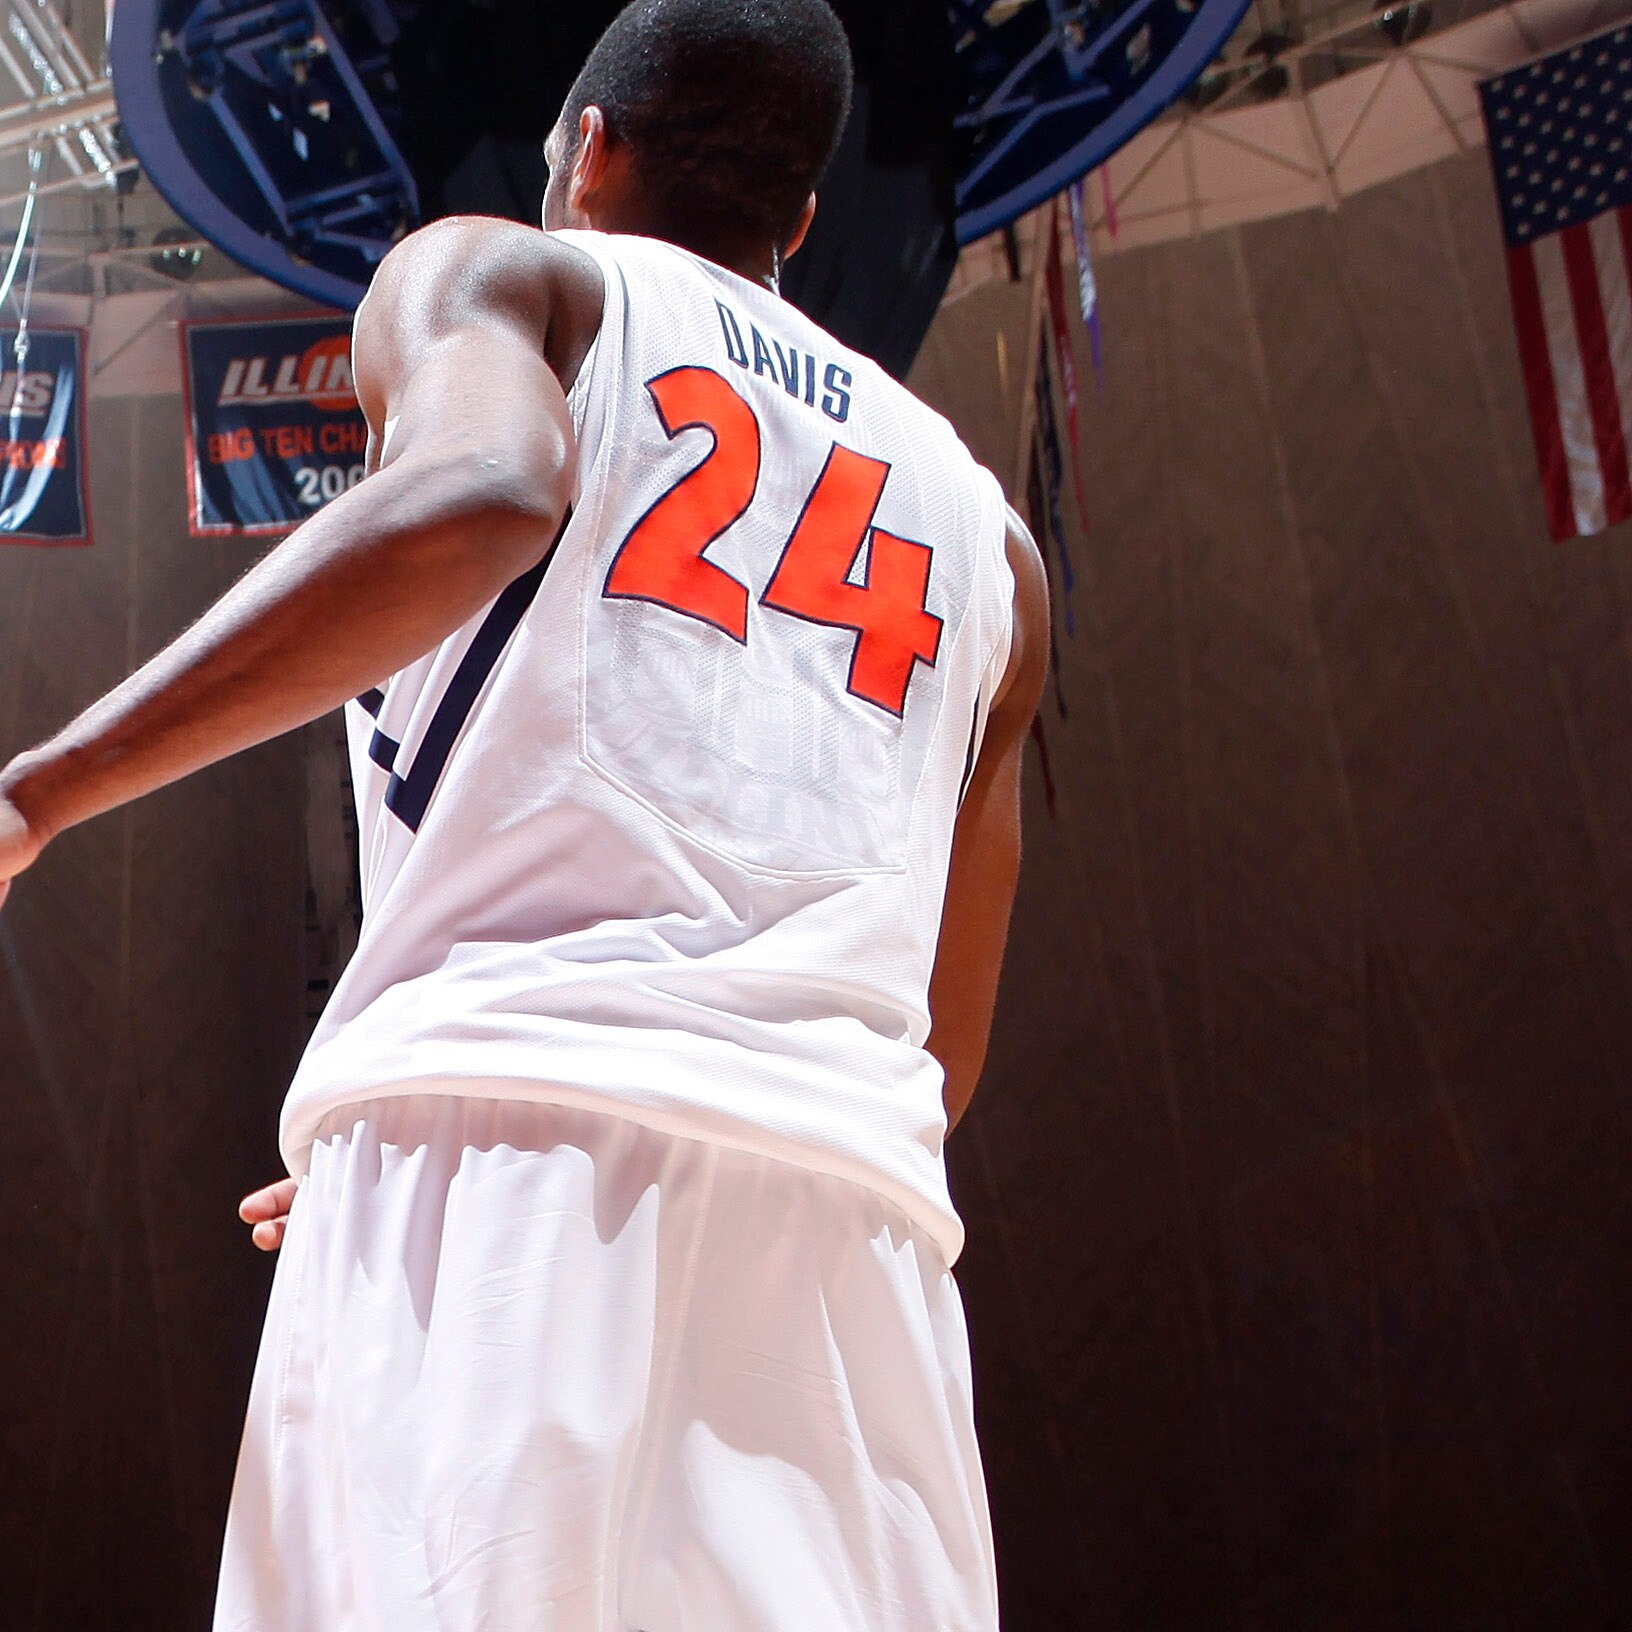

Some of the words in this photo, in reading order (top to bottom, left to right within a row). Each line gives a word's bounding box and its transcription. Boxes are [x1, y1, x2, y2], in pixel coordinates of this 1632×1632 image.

[714, 299, 854, 424] DAVIS
[208, 427, 254, 464] BIG
[260, 424, 313, 459] TEN
[602, 364, 944, 719] 24
